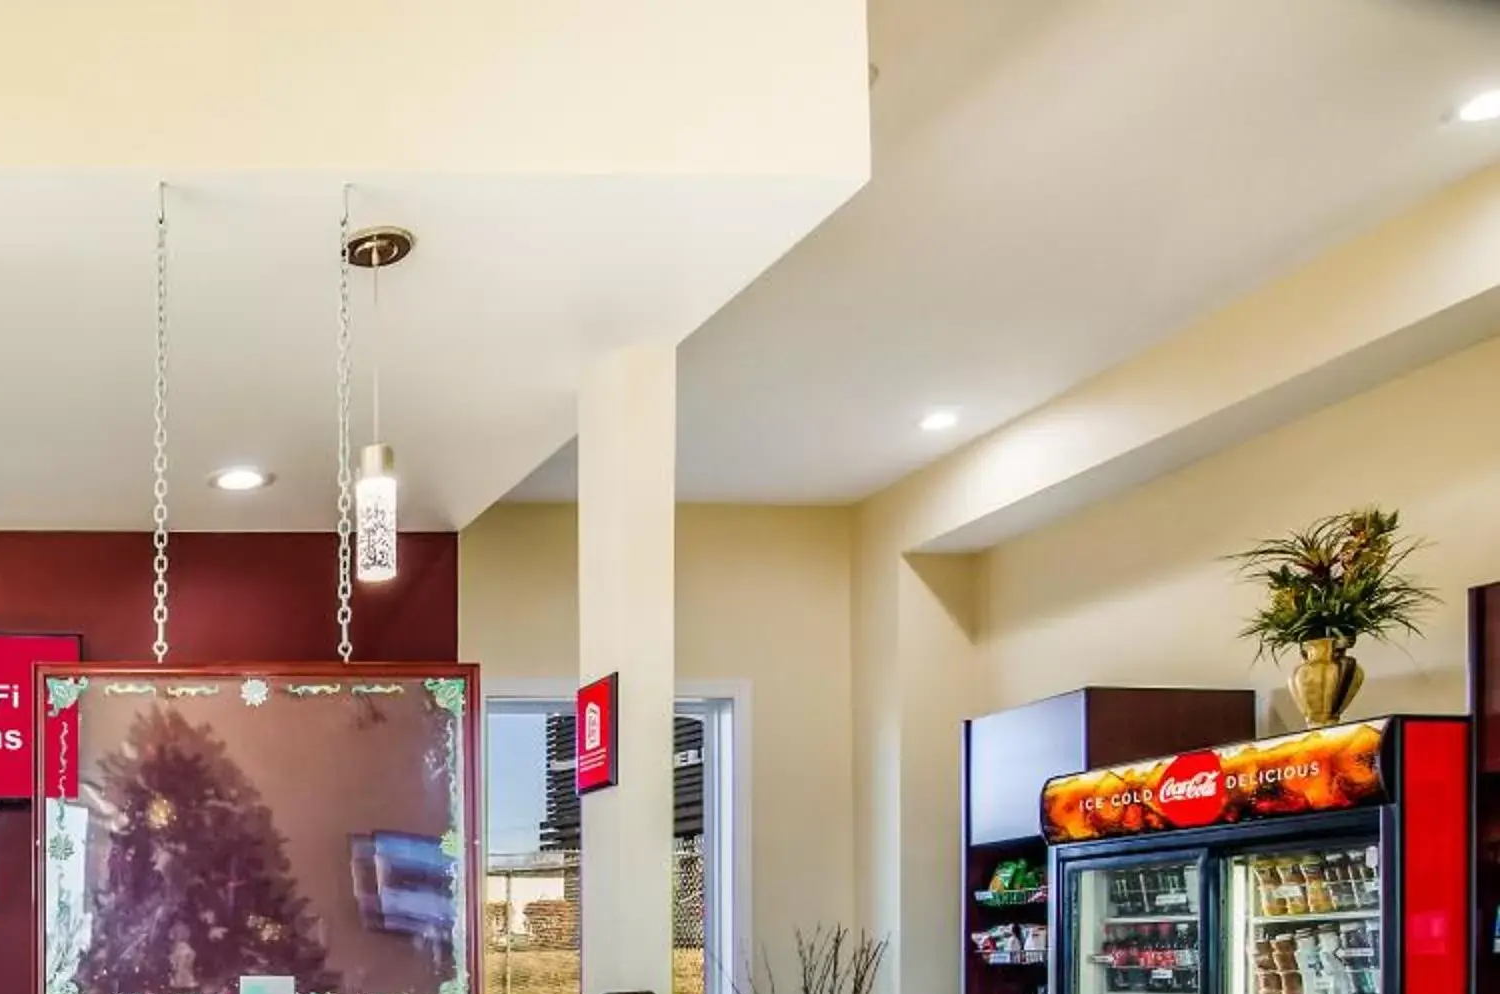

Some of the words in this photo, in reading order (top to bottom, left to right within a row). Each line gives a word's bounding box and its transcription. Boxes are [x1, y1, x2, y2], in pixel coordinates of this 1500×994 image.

[1079, 796, 1105, 813] ICE
[1111, 788, 1153, 807] COLD
[1225, 761, 1320, 789] DELICIOUS
